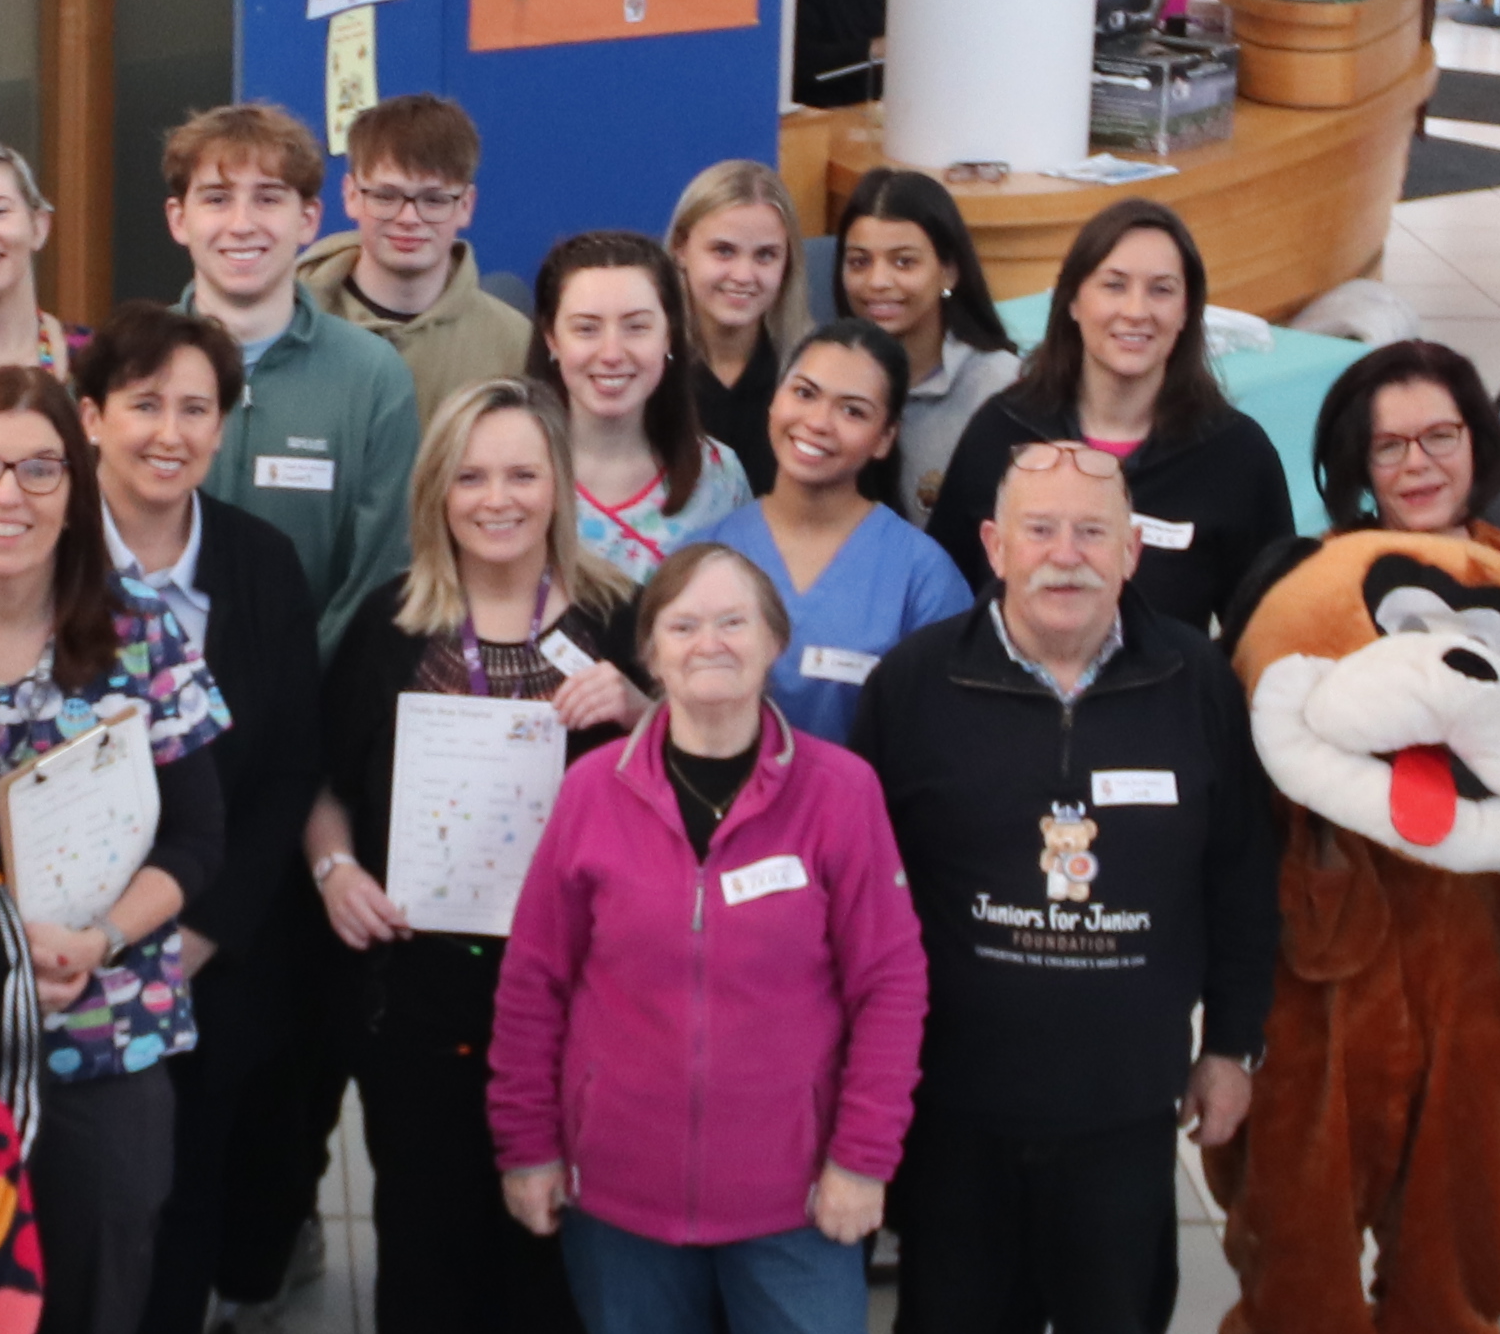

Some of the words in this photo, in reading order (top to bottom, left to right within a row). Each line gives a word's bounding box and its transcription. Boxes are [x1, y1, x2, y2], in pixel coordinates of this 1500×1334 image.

[971, 891, 1046, 929] Juniors
[1084, 902, 1152, 933] Juniors
[1012, 930, 1117, 954] FOUNDATION
